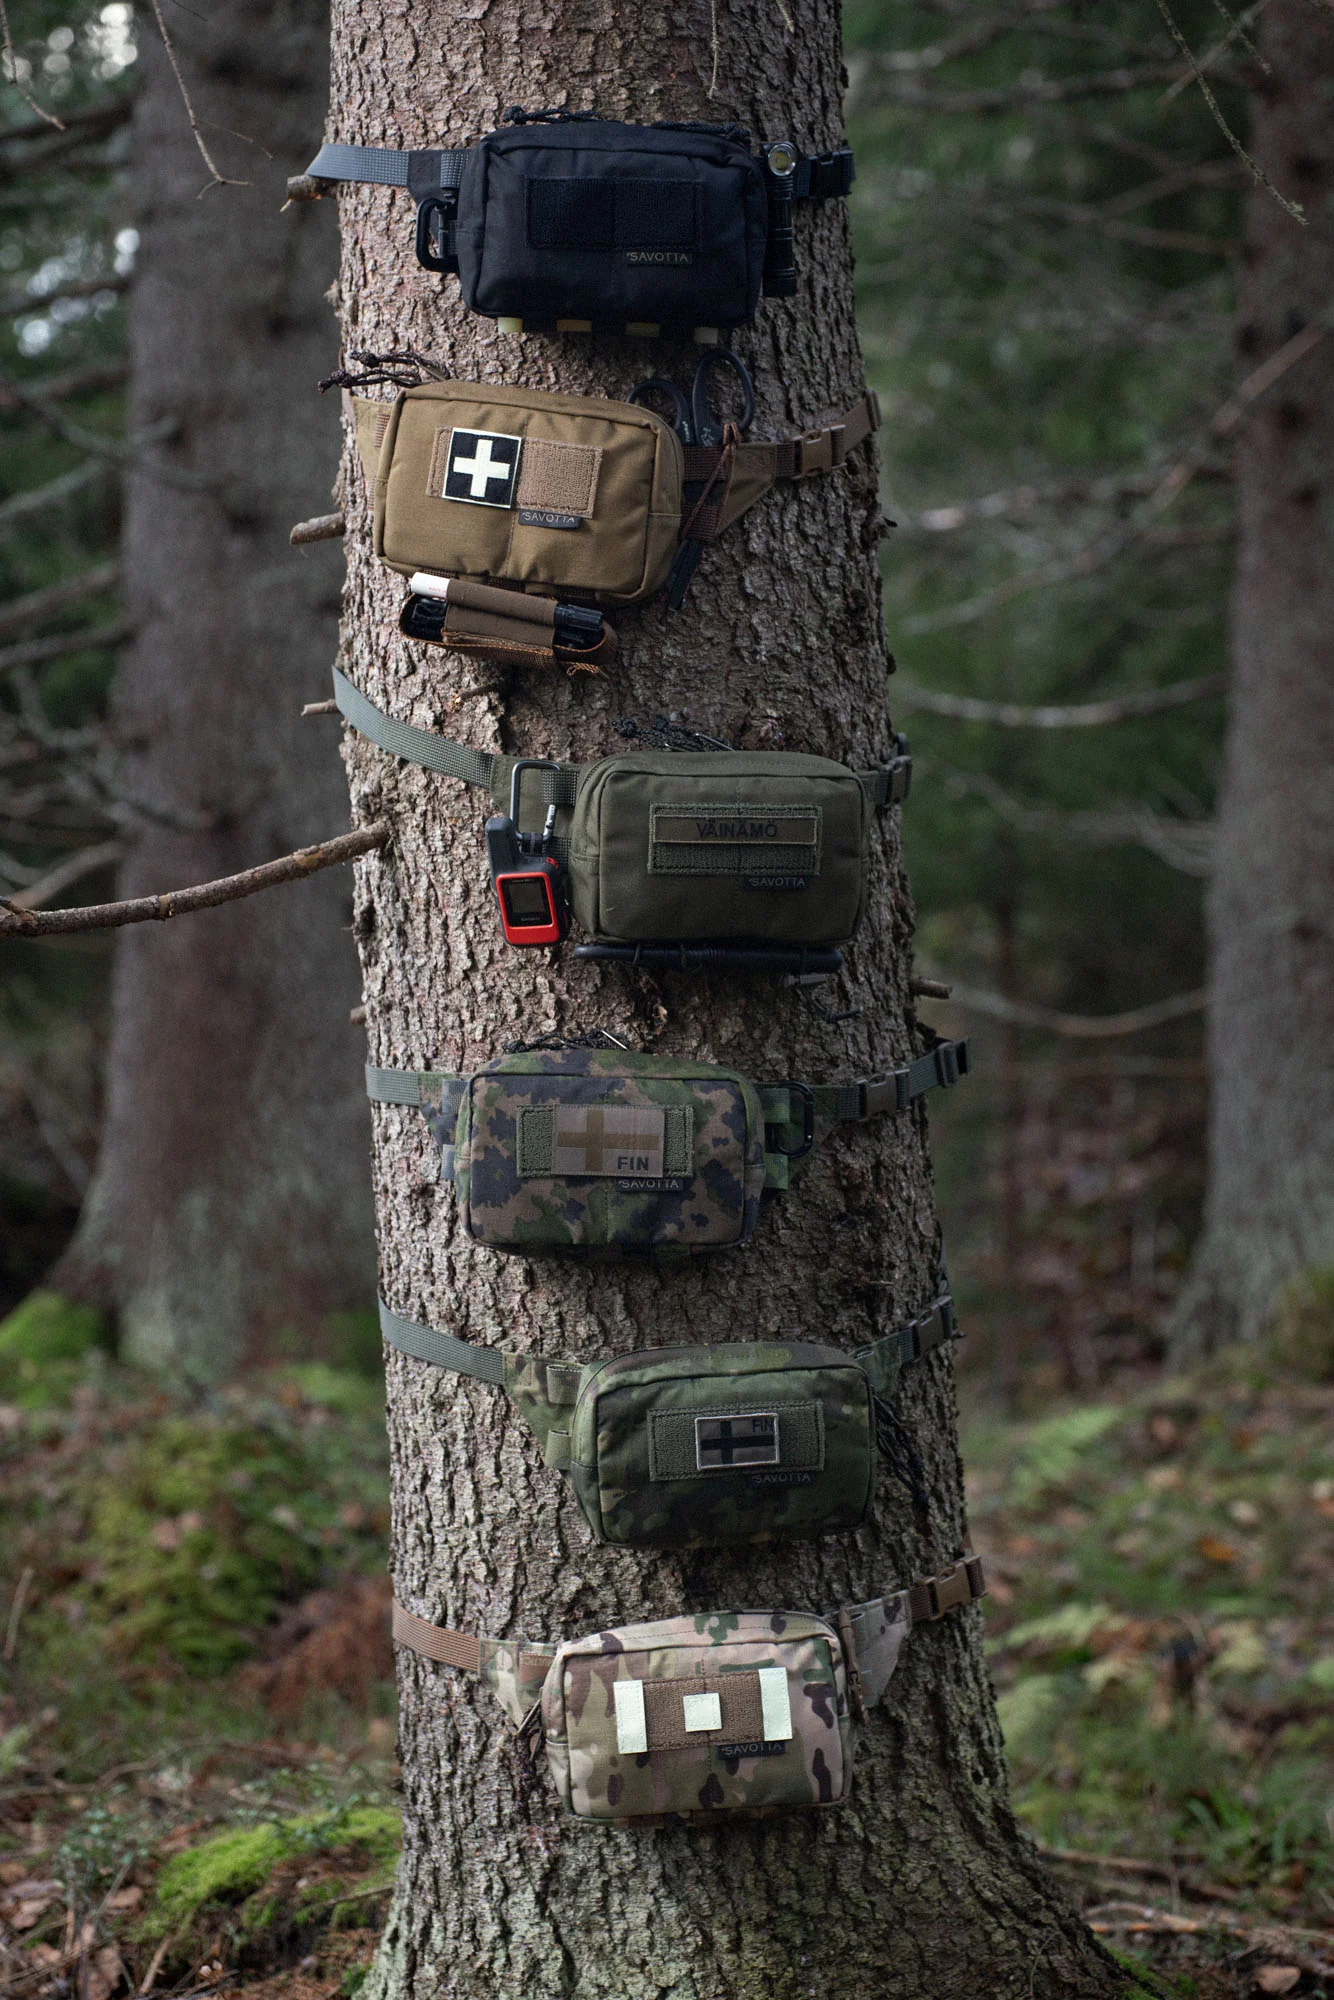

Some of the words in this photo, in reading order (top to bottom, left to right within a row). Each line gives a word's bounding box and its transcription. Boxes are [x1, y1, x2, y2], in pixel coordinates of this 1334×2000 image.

[627, 251, 689, 262] SAVOTTA
[522, 511, 575, 524] SAVOTTA
[696, 819, 778, 838] VÄINÄMÖ
[749, 877, 806, 888] SAVOTTA
[617, 1156, 649, 1171] FIN
[619, 1179, 679, 1189] SAVOTTA
[752, 1418, 774, 1433] FIN
[752, 1472, 811, 1484] SAVOTTA
[721, 1742, 782, 1756] SAVOTTA
